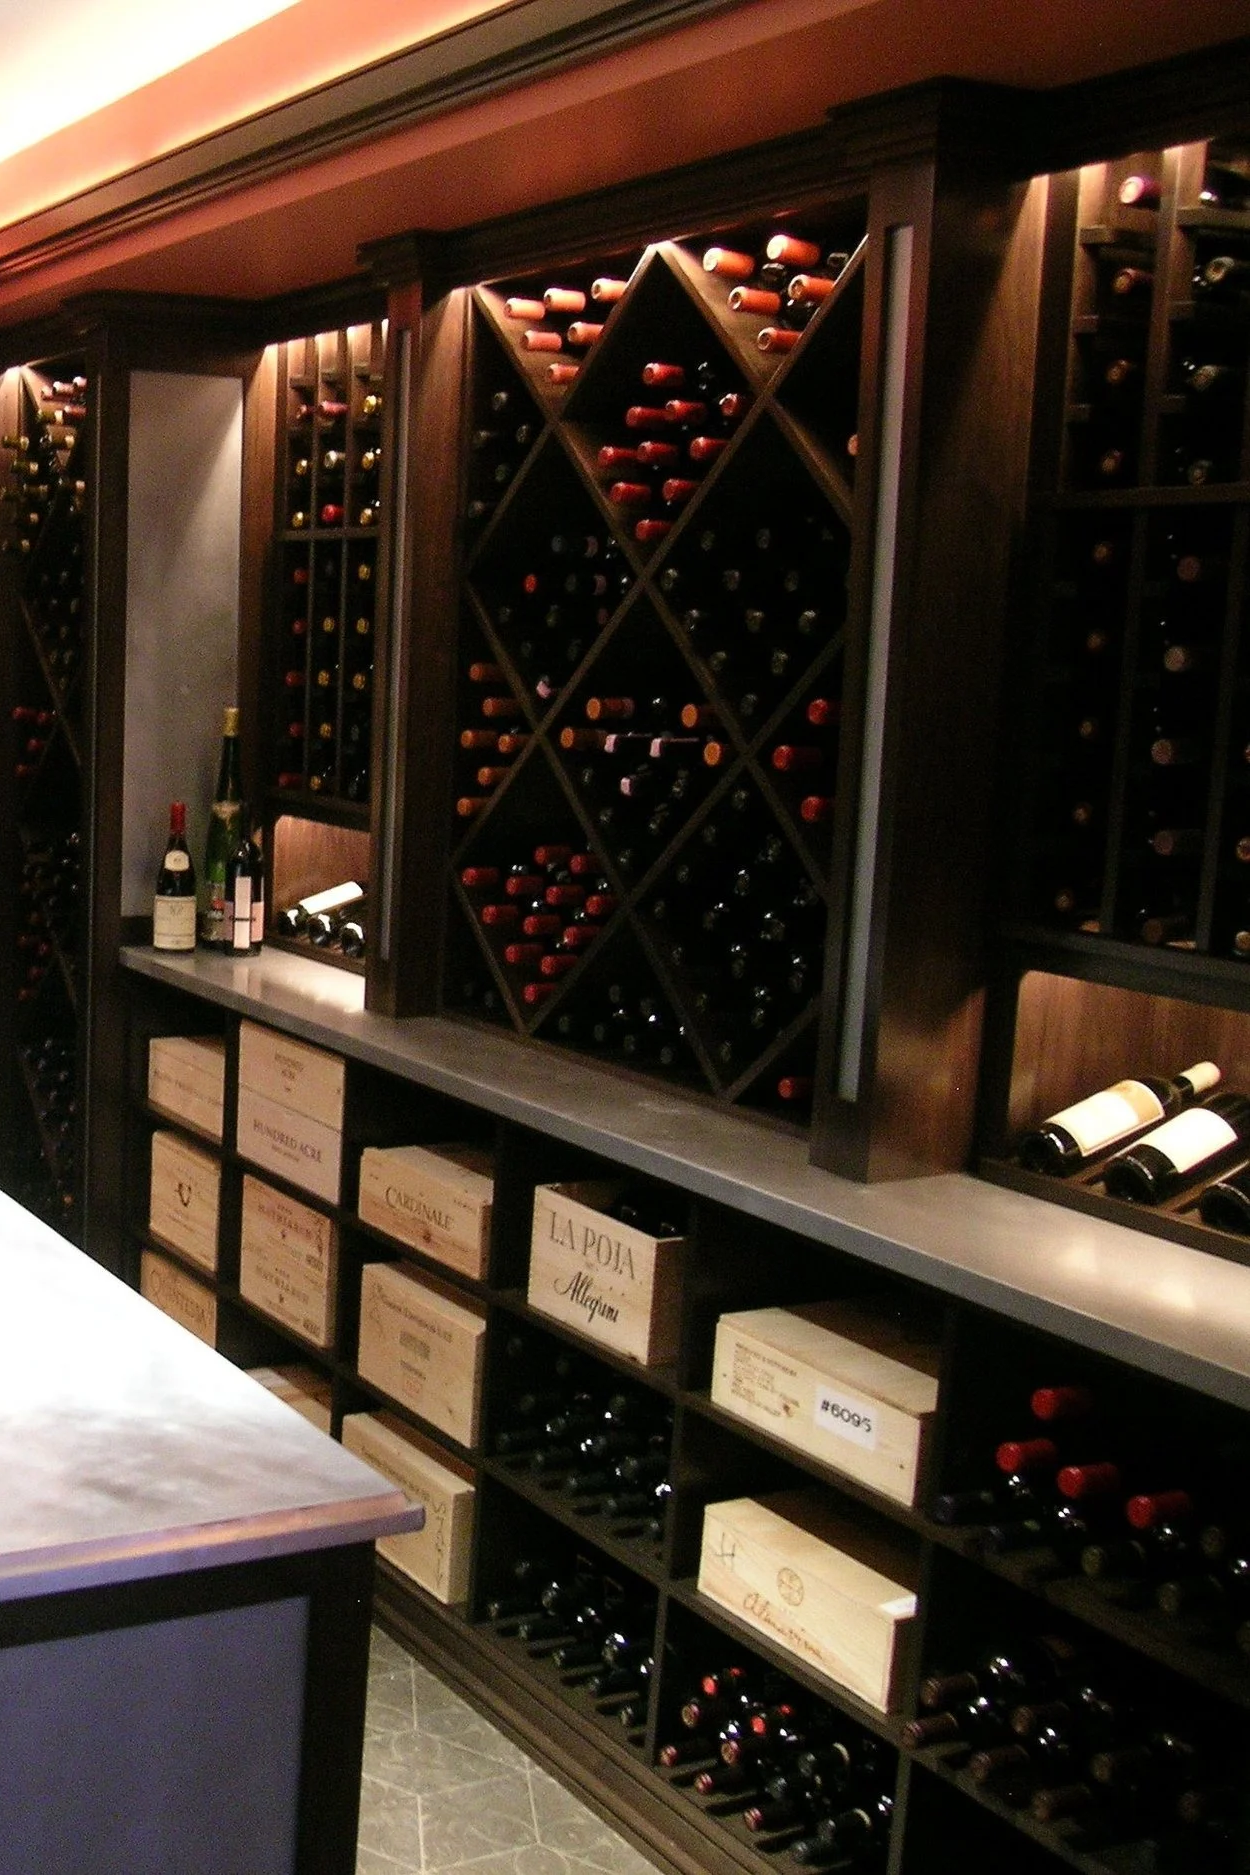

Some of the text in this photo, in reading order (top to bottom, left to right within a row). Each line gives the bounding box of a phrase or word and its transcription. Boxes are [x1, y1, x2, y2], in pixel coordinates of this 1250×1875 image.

[385, 1185, 454, 1230] CARDINALE
[549, 1210, 575, 1251] LA
[553, 1271, 619, 1323] Allegrini
[820, 1398, 872, 1433] #6095
